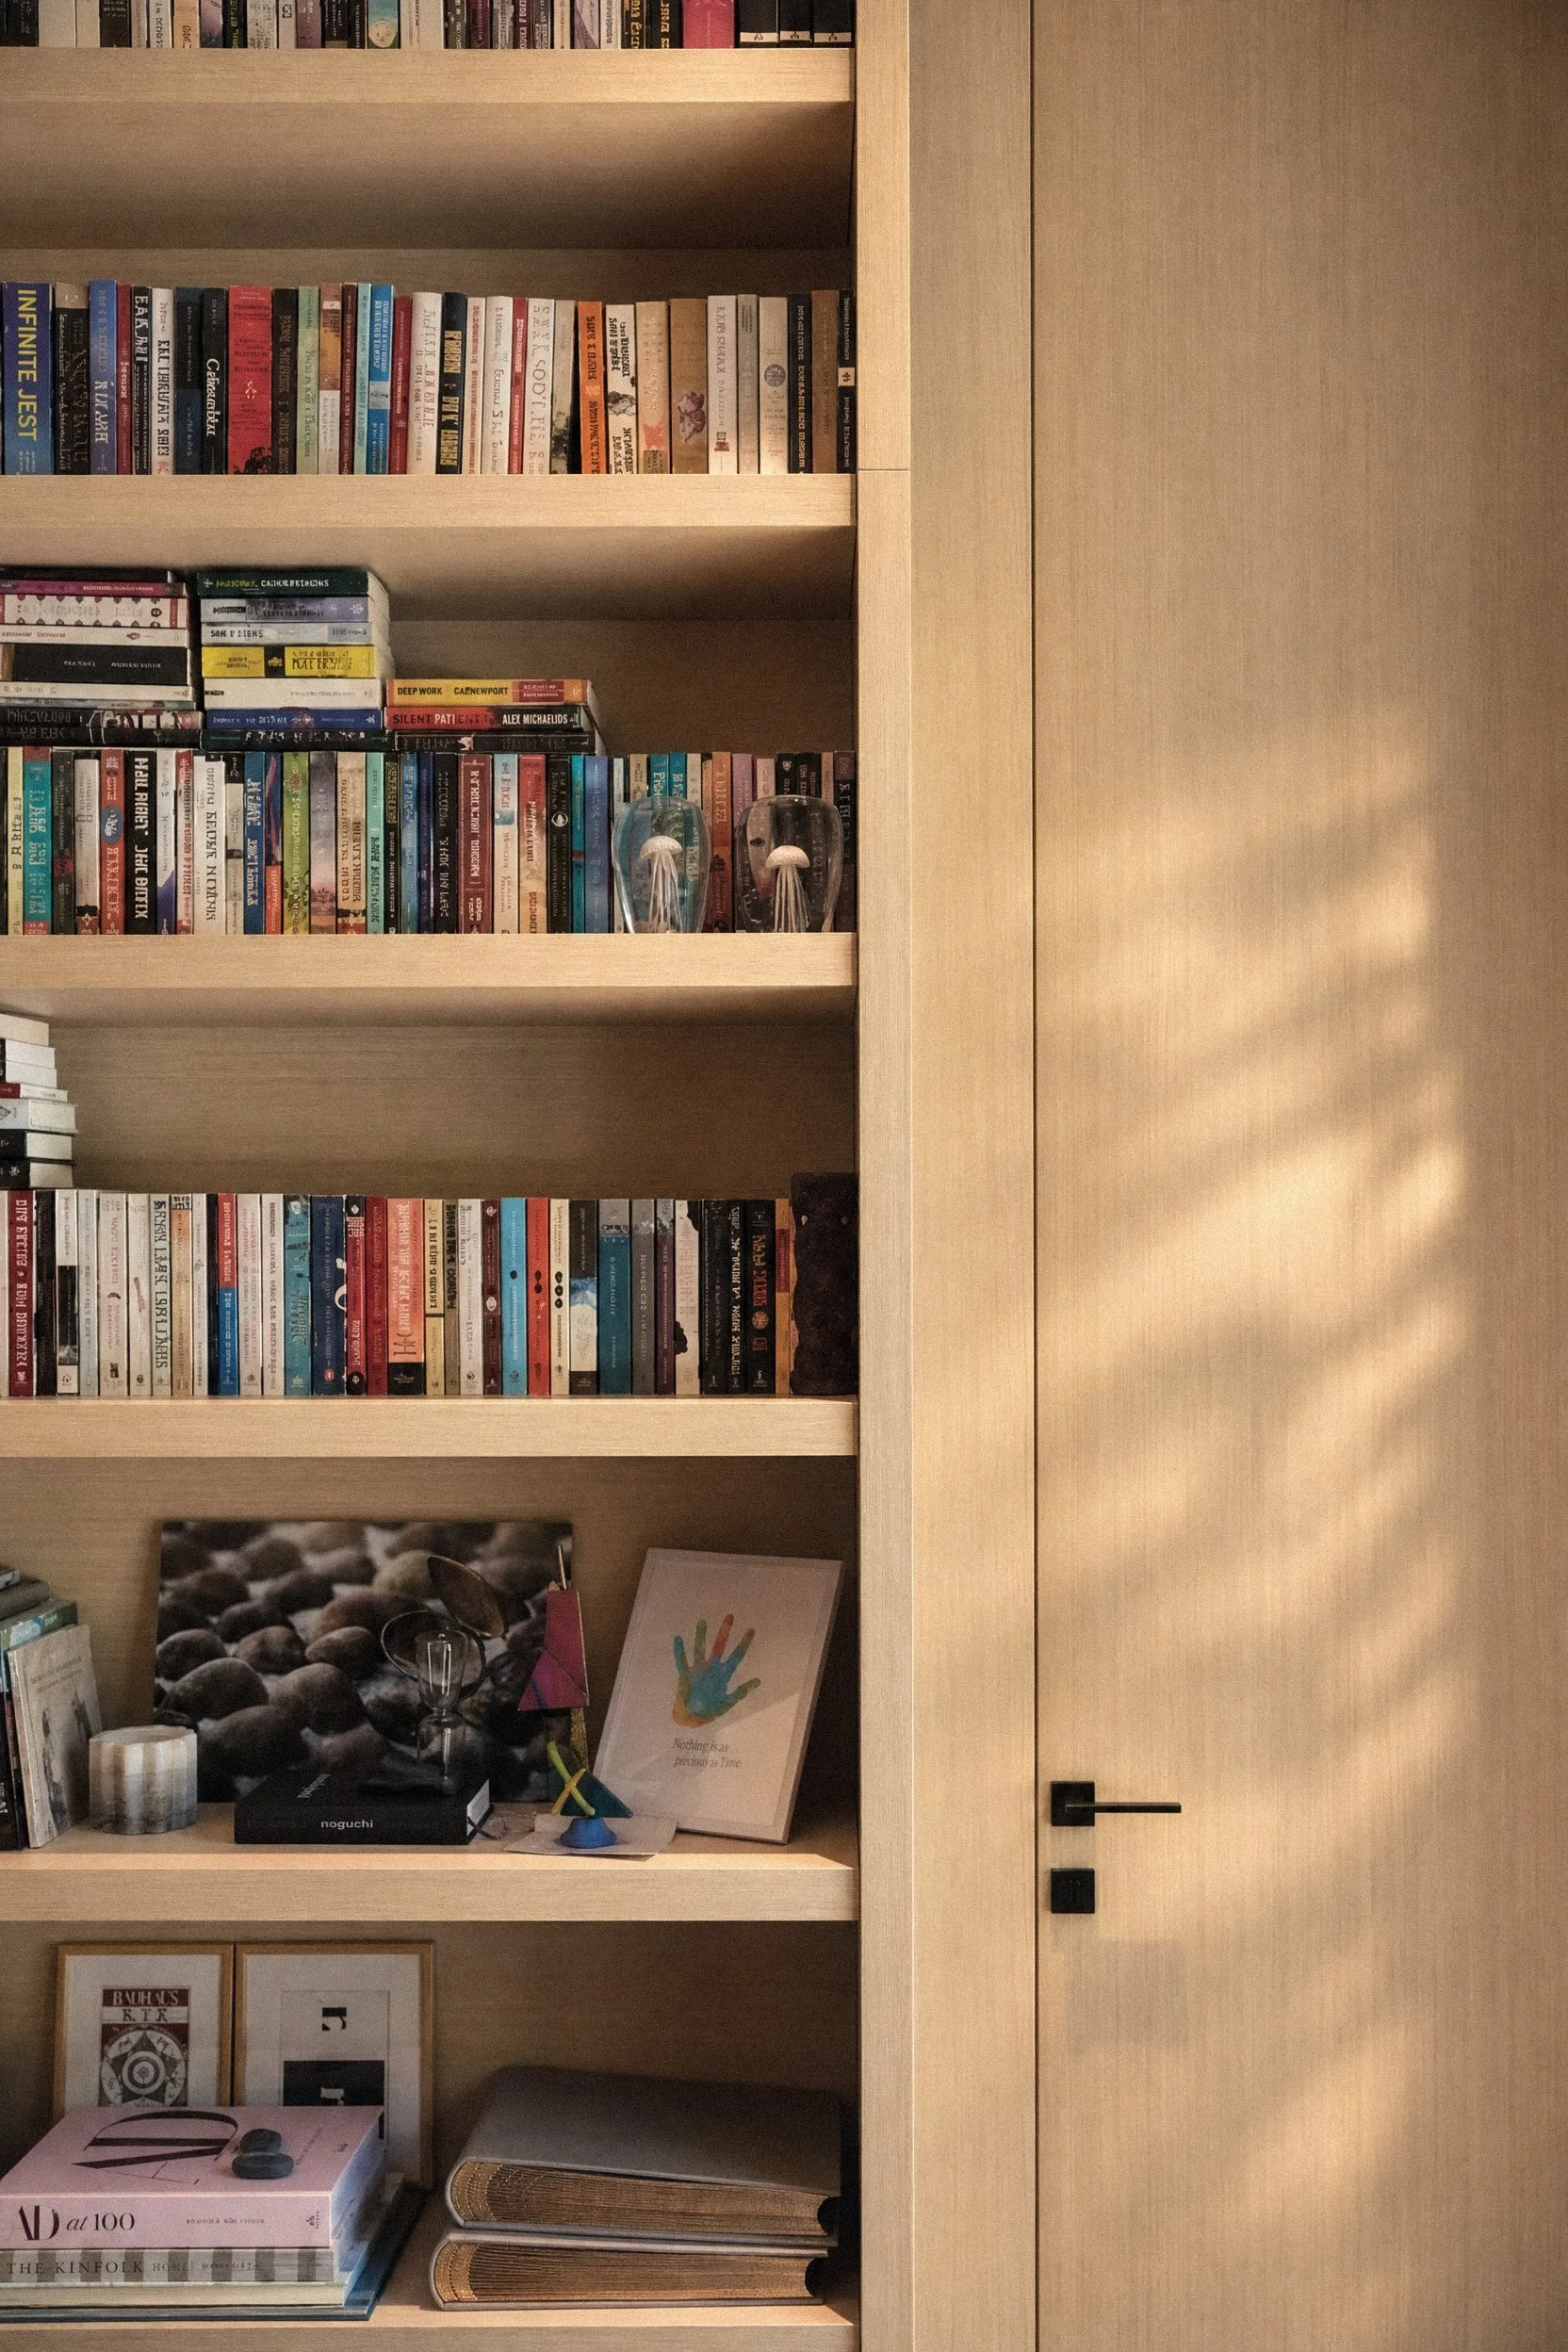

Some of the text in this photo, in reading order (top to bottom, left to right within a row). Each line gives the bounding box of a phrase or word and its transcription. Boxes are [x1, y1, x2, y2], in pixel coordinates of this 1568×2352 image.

[17, 289, 38, 383] INFINITE
[17, 390, 38, 442] JEST
[397, 687, 417, 695] DEEP
[418, 687, 443, 695] WORK
[469, 687, 508, 695] NEWPORT
[393, 714, 431, 725] SILENT
[502, 713, 520, 725] ALEX
[673, 1739, 708, 1754] Nothing
[719, 1743, 729, 1753] as
[320, 1820, 374, 1830] noguchi
[66, 2215, 89, 2231] at
[93, 2213, 136, 2231] 100
[6, 2262, 45, 2275] THE
[56, 2262, 144, 2274] KINFOLK
